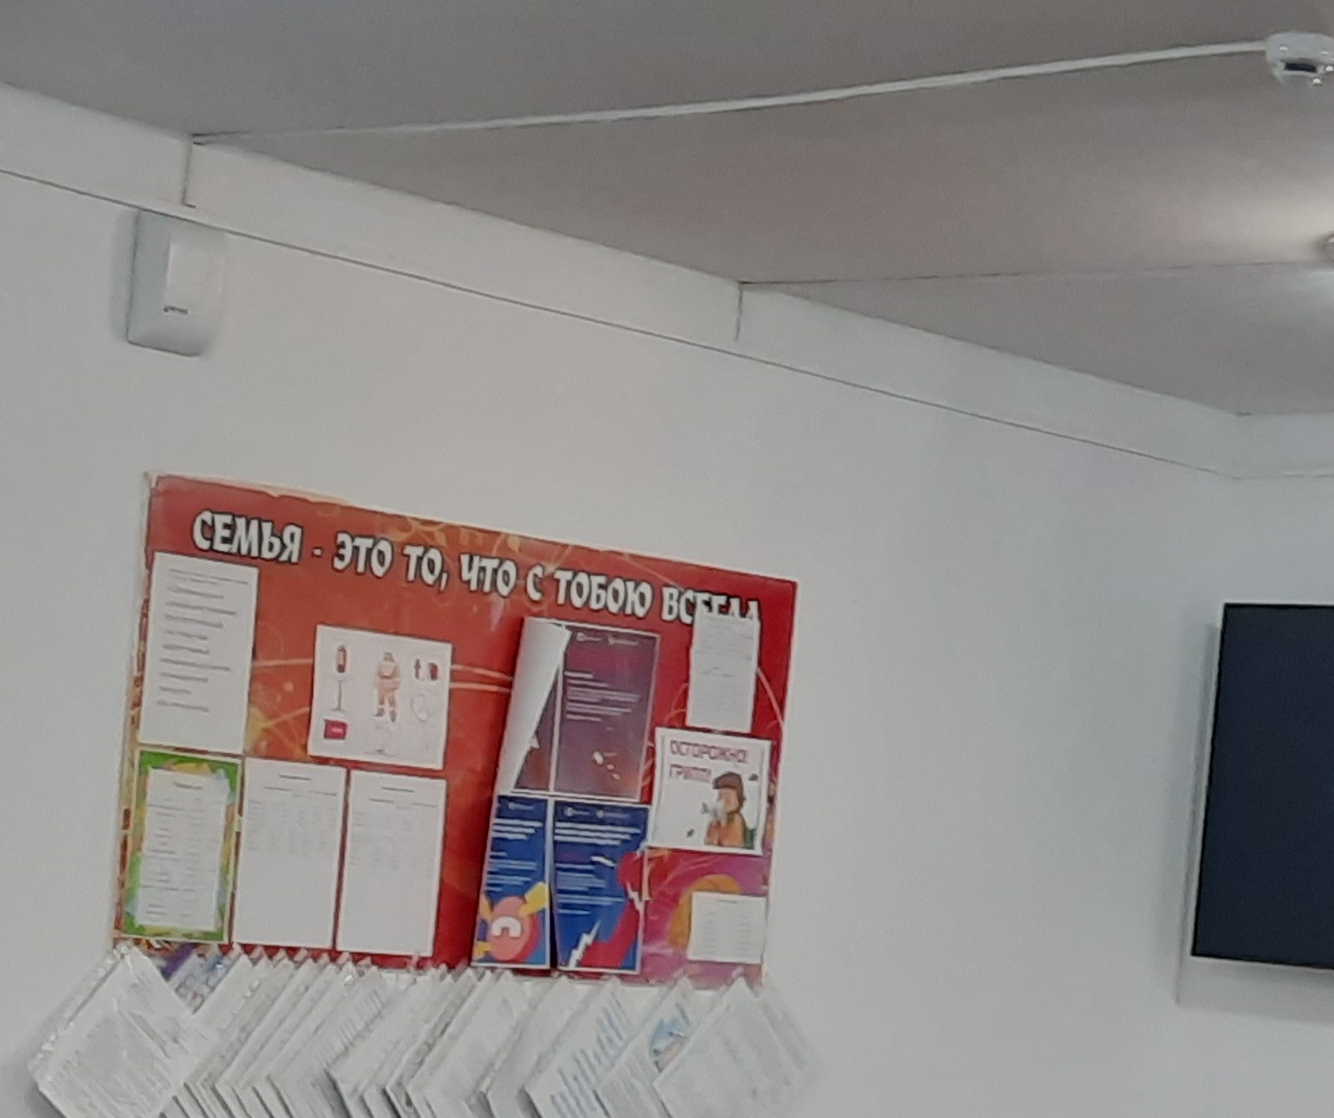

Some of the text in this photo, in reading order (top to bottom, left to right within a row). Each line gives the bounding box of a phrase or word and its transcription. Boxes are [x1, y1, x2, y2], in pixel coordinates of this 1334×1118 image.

[192, 510, 303, 564] СЕМЬЯ
[333, 532, 393, 578] ЭТО
[403, 545, 449, 592] ТО,
[460, 553, 517, 597] ЧТО
[526, 564, 544, 601] С
[553, 569, 653, 618] ТОБОЮ
